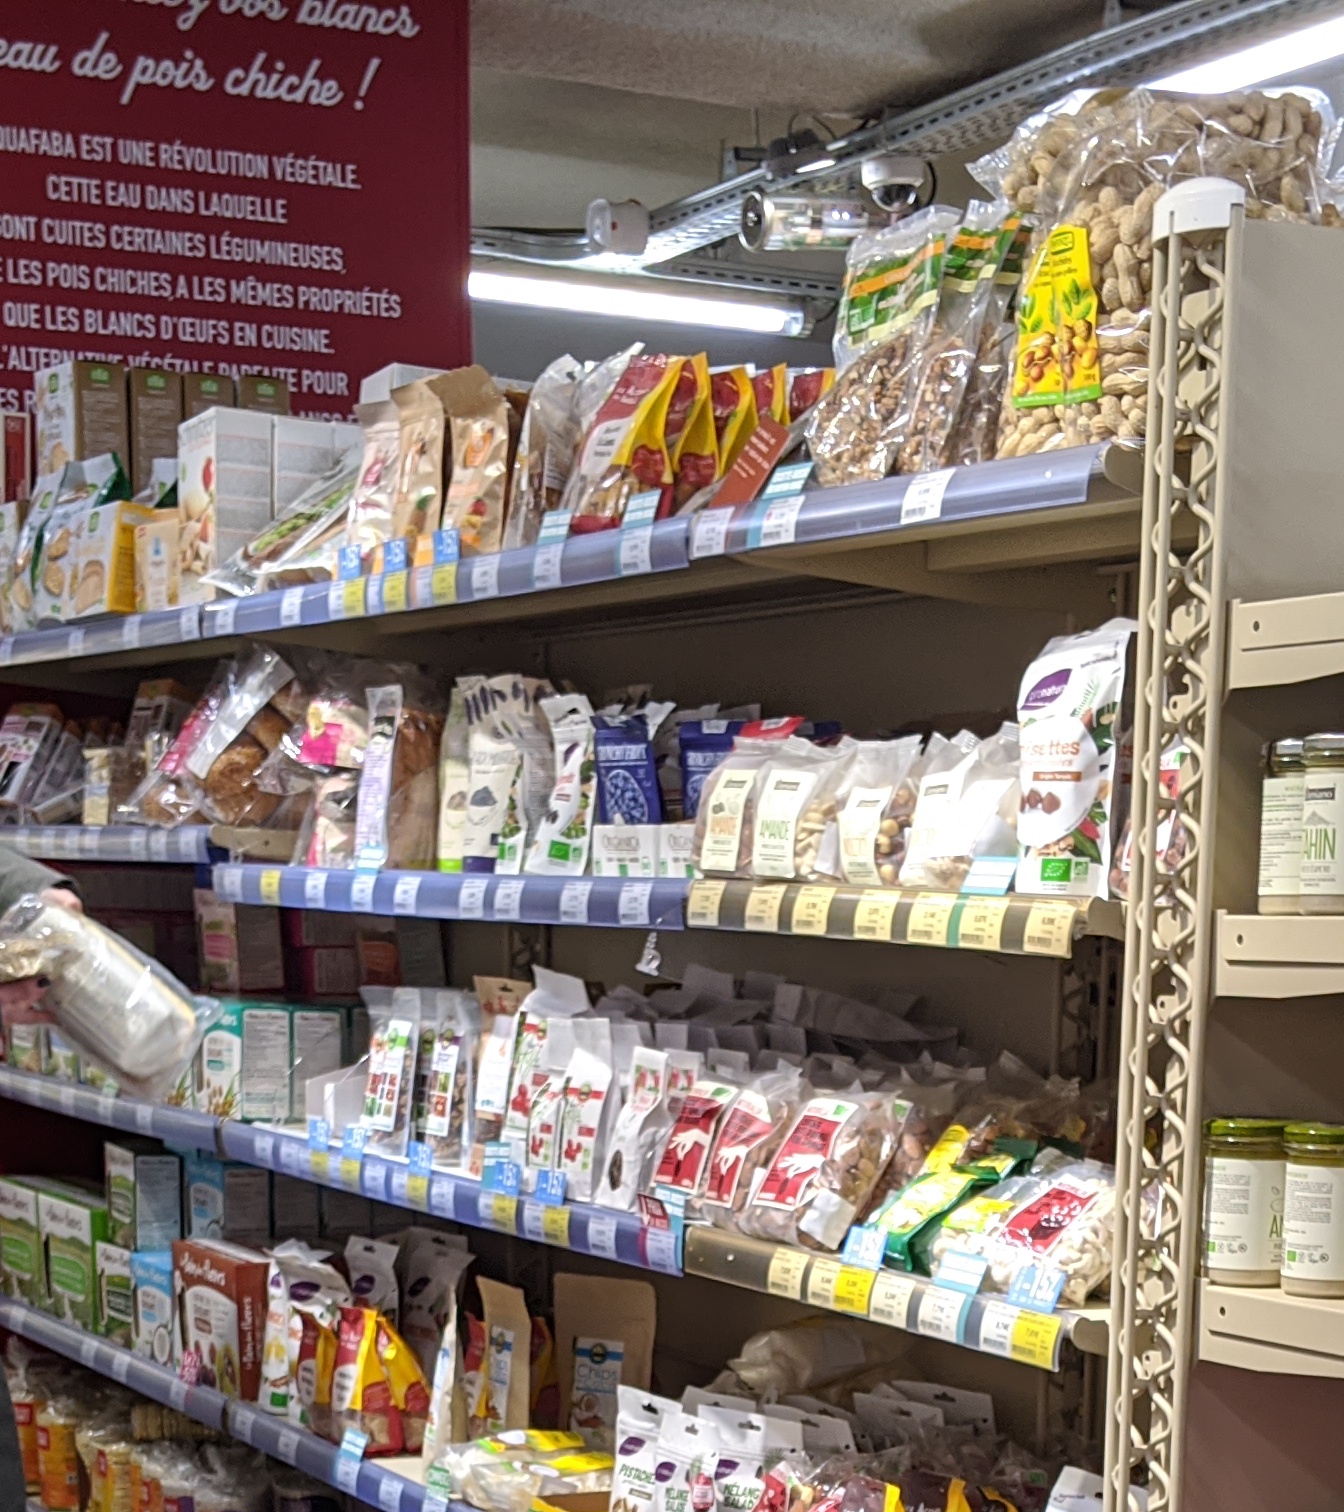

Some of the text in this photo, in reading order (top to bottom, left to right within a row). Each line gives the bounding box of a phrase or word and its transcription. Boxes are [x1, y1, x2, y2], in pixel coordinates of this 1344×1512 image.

[72, 31, 123, 80] de
[119, 49, 215, 105] pois
[223, 51, 344, 107] chiche
[79, 133, 116, 163] EST
[117, 138, 156, 168] UNE
[159, 140, 270, 180] RÉVOLUTION
[272, 152, 362, 190] VÉGÉTALE.
[46, 173, 288, 224] CETTE EAU DANS LAQUELLE
[41, 218, 106, 249] CUITES
[110, 224, 207, 258] CERTAINES
[209, 230, 348, 275] LÉGUMINEUSES,
[6, 258, 43, 287] LES
[46, 262, 91, 290] POIS
[175, 276, 190, 299] A
[193, 276, 227, 303] LES
[230, 275, 294, 309] MÊMES
[298, 285, 402, 319] PROPRIÉTÉS
[2, 301, 336, 354] QUE LES BLANCS D'ŒUFS EN CUISINE.
[302, 369, 349, 397] POUR
